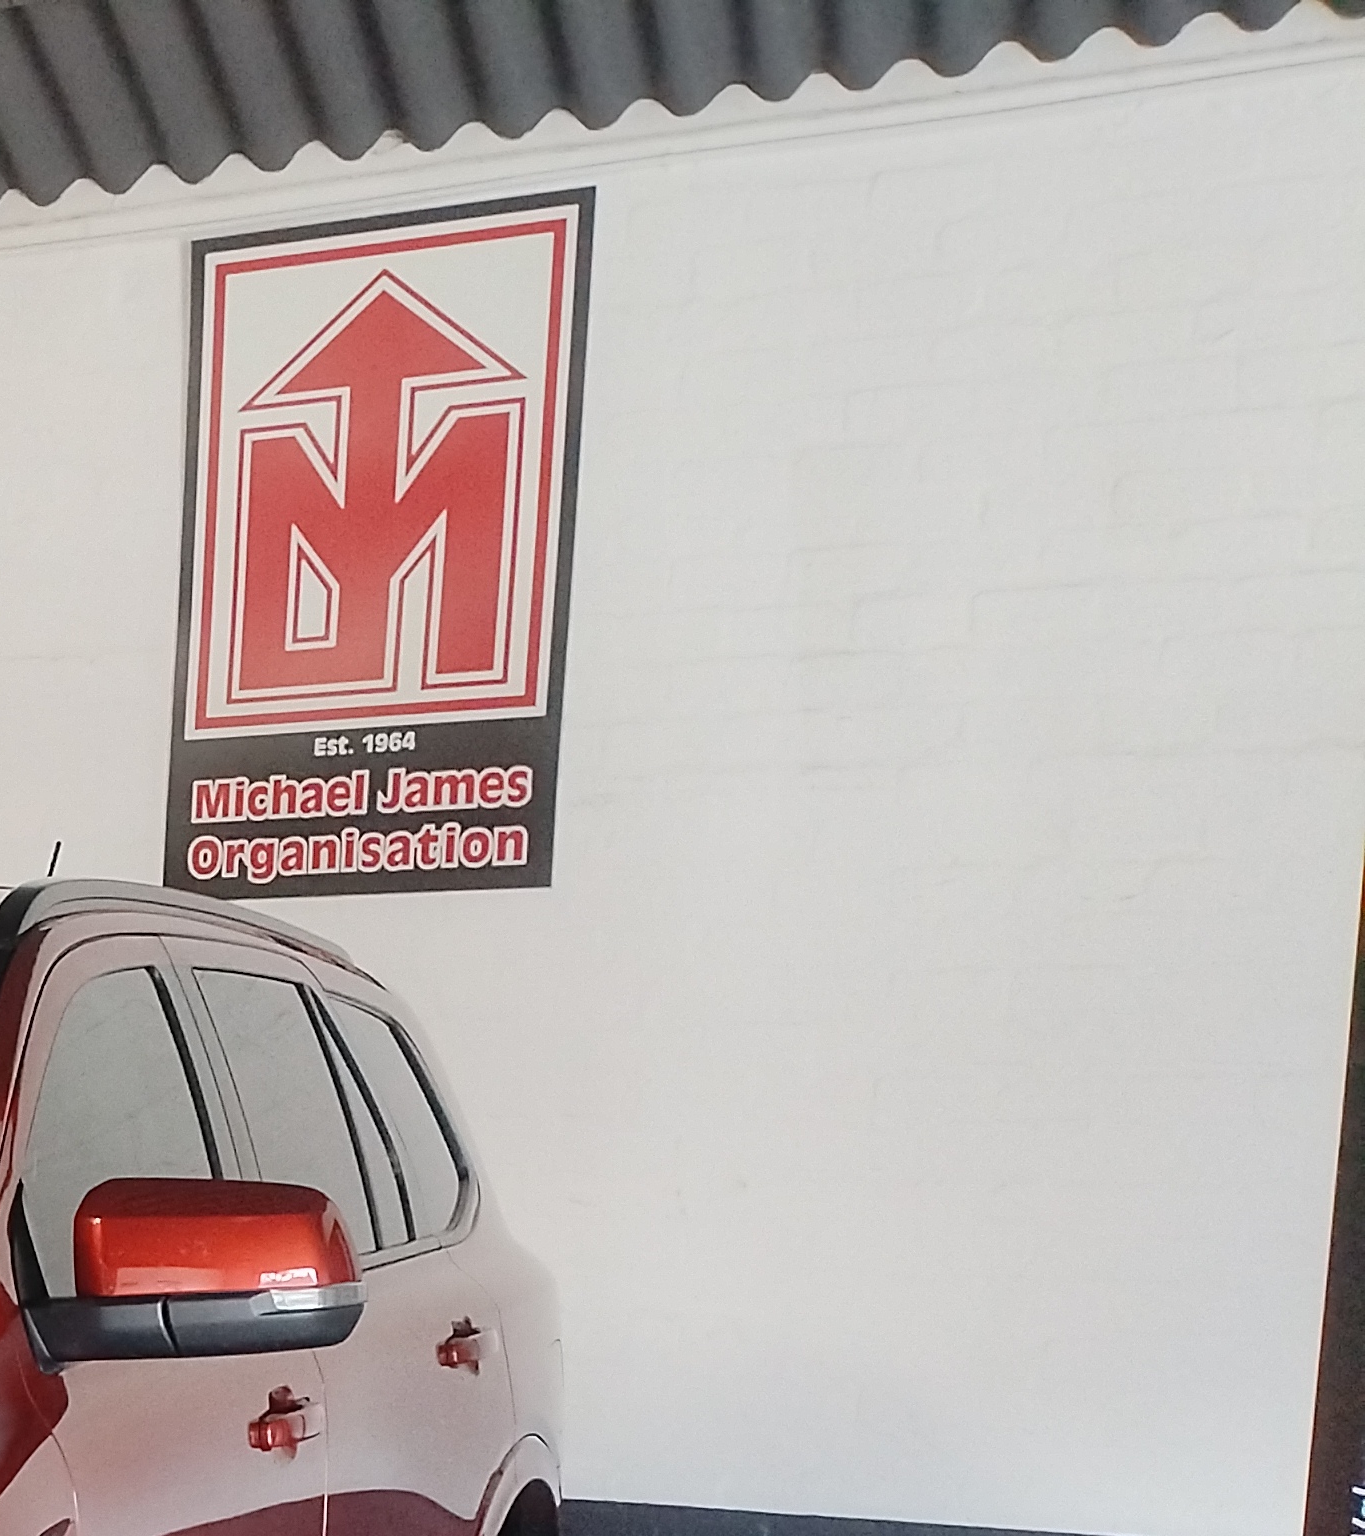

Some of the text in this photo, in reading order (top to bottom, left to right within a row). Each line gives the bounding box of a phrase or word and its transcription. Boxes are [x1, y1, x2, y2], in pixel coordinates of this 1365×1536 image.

[313, 731, 416, 757] Est. 1964
[191, 765, 533, 824] Michael James
[187, 822, 529, 884] Organisation
